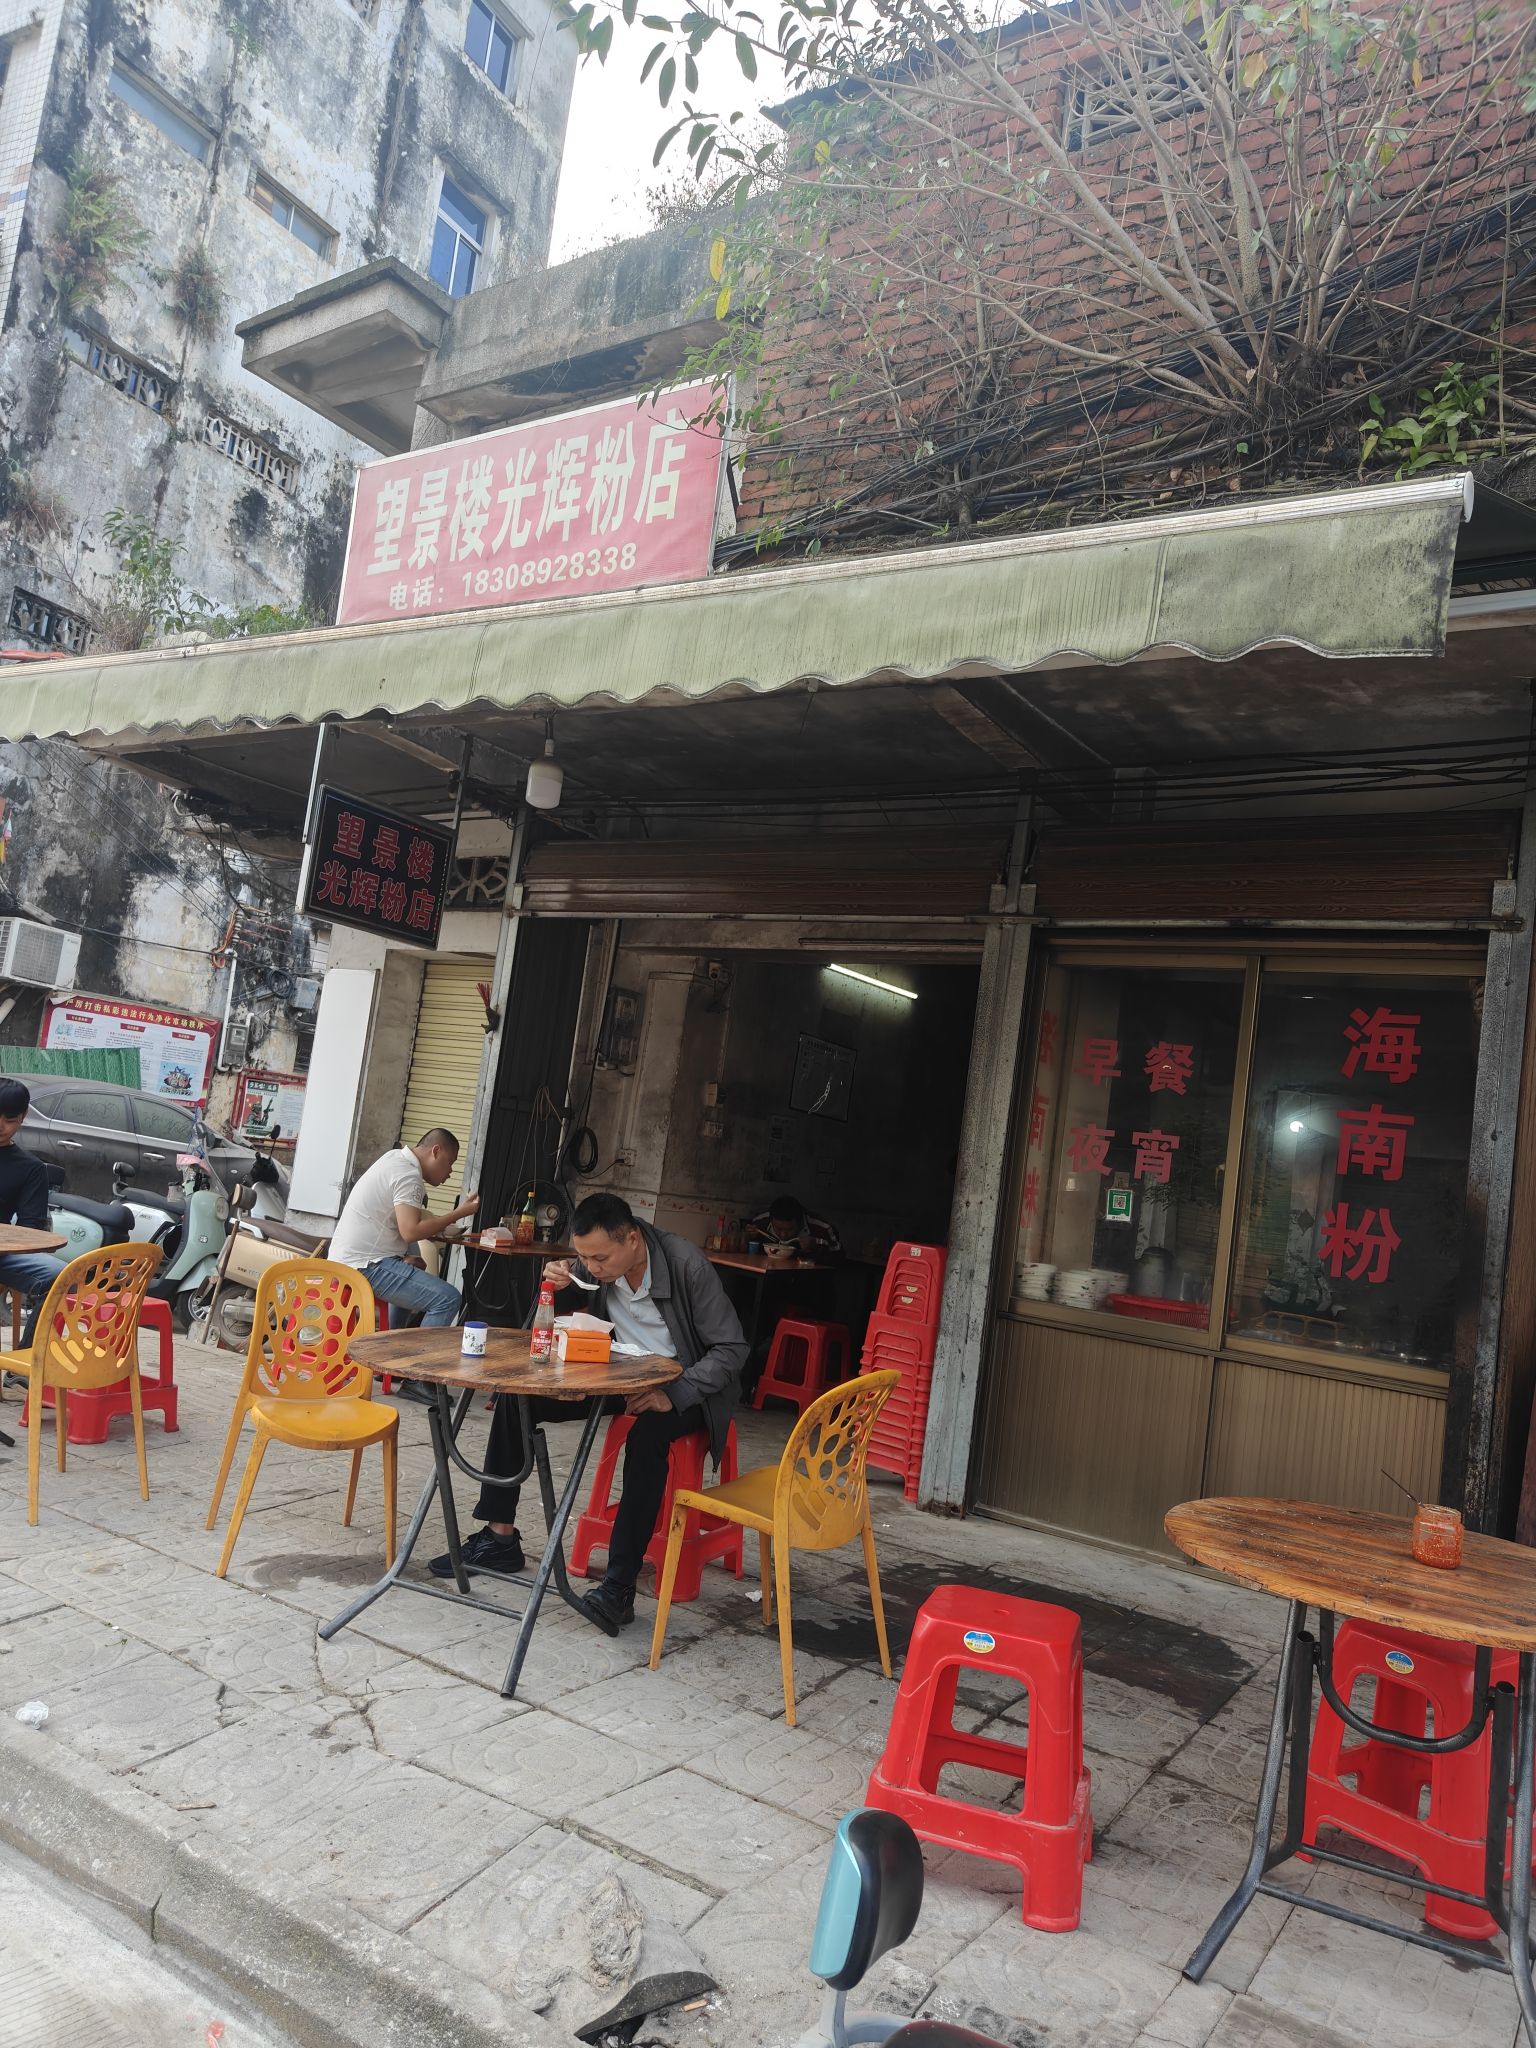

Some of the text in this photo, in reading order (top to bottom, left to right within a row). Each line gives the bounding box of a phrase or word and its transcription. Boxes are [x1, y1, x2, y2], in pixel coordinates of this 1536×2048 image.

[367, 407, 692, 576] 望景楼光辉粉店
[462, 543, 637, 597] 18308928338
[333, 811, 434, 882] 望景楼
[317, 860, 435, 931] 光辉粉店
[1073, 1038, 1194, 1095] 早餐
[1066, 1124, 1180, 1183] 夜宵
[1318, 1007, 1422, 1283] 海南粉
